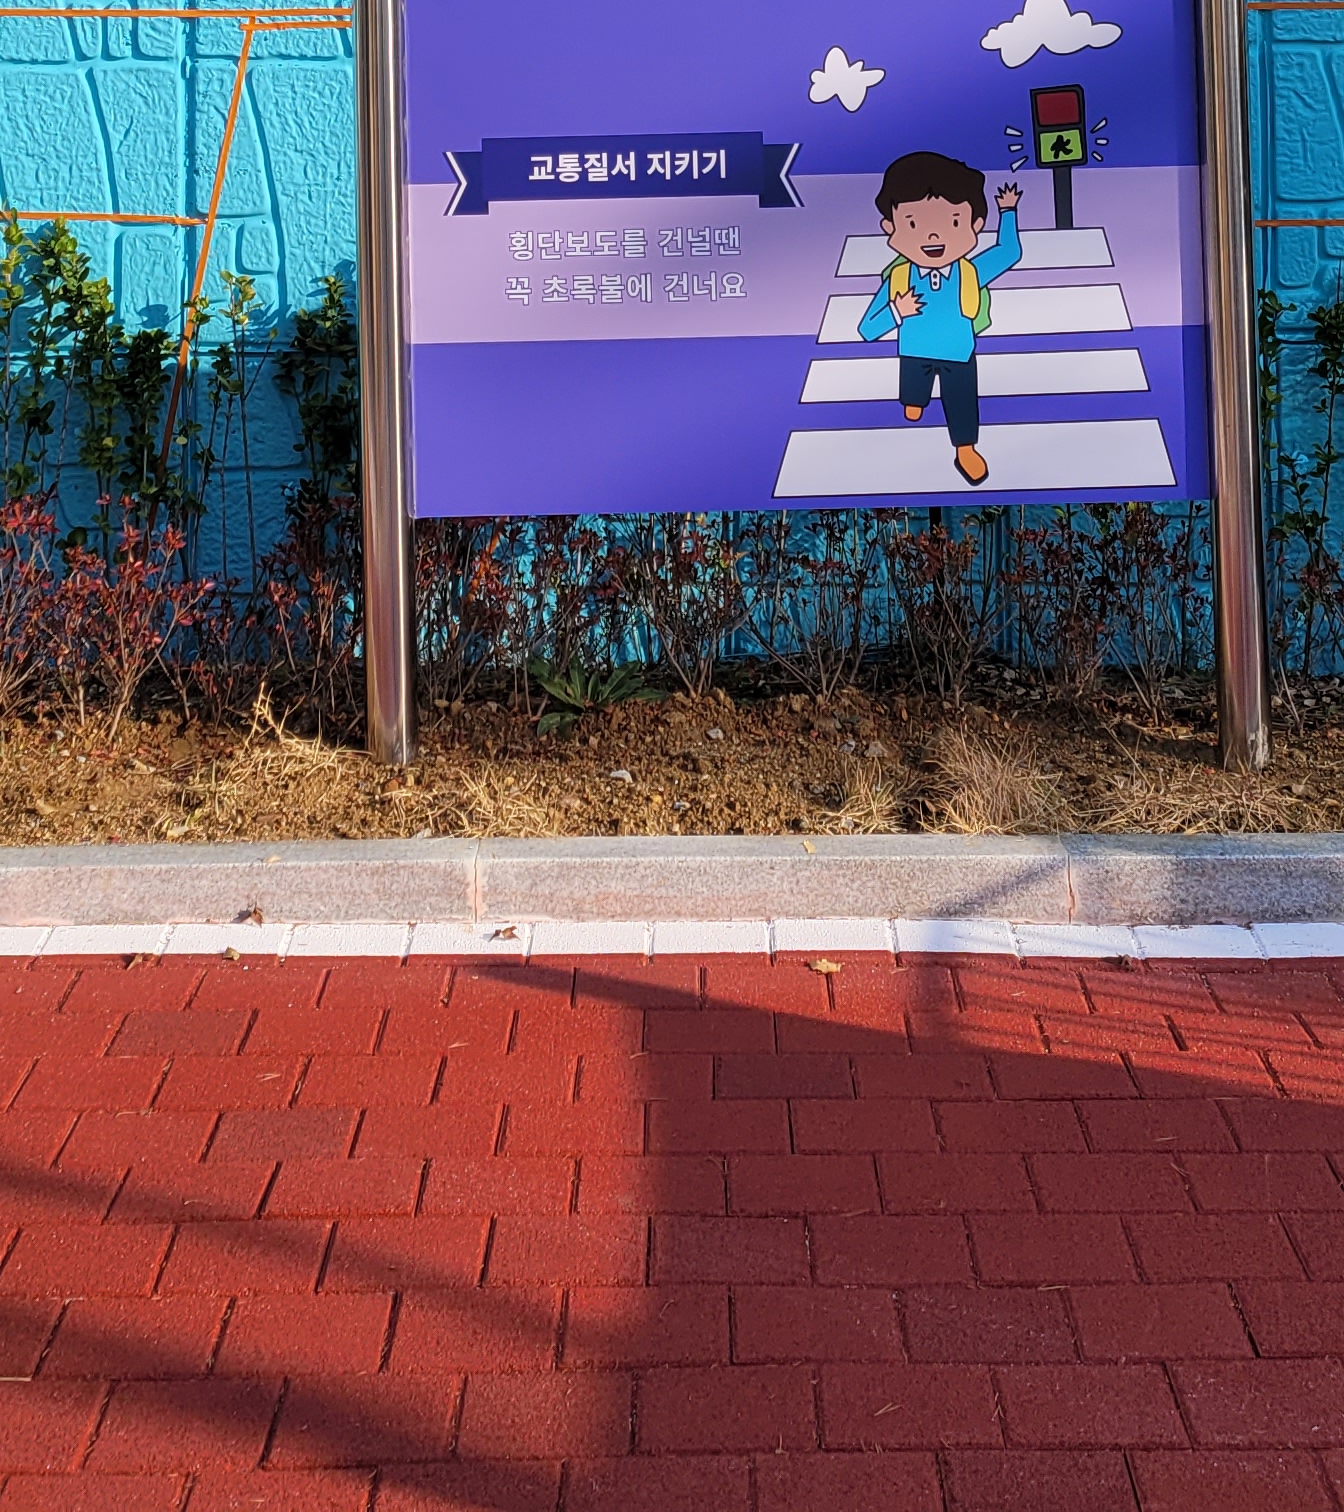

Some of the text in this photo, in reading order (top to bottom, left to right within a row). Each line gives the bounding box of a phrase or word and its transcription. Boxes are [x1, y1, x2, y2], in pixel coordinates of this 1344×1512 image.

[527, 149, 727, 183] 교통질서 지키기
[507, 225, 742, 262] 횡단보도를 건널땐
[504, 271, 747, 306] 꼭 초록불에 건너요
